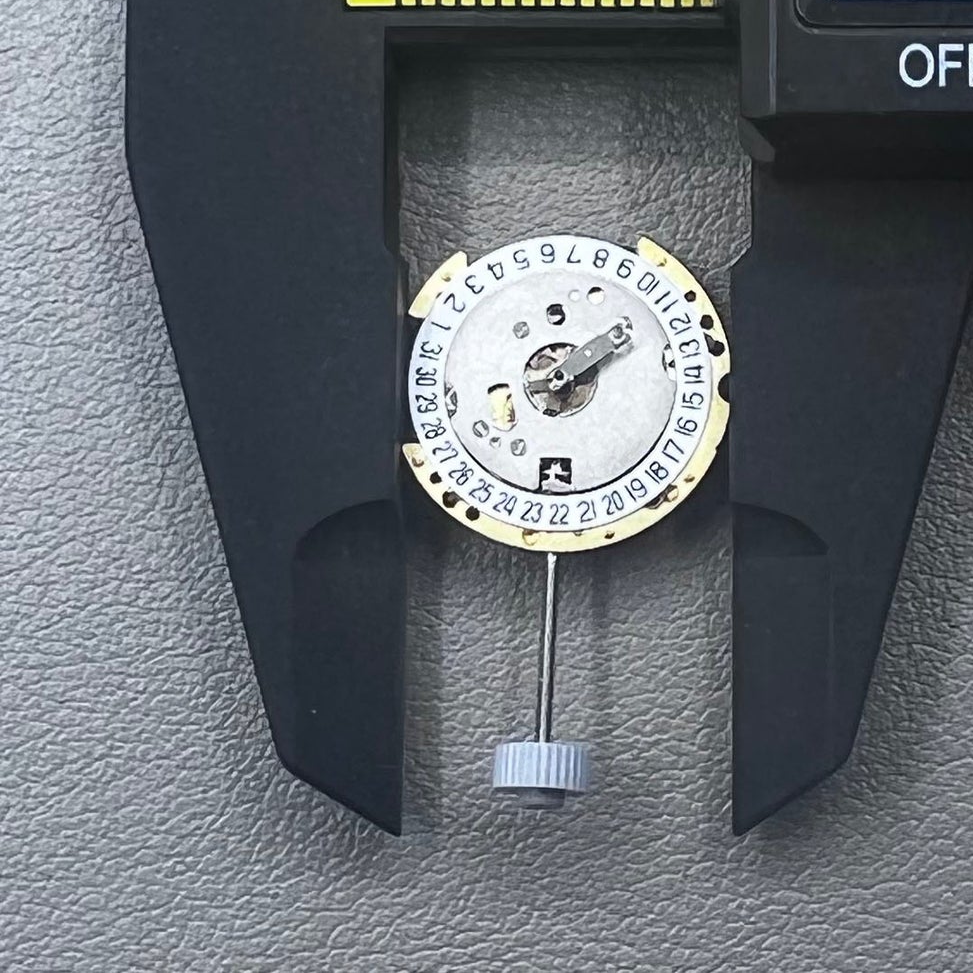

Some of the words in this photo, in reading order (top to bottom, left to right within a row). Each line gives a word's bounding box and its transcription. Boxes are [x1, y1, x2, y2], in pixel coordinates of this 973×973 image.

[513, 249, 530, 270] 5
[541, 243, 555, 263] 6
[567, 244, 581, 263] 7
[593, 248, 609, 268] 8
[487, 262, 504, 280] 4
[617, 259, 635, 278] 9
[465, 275, 485, 294] 3
[637, 271, 660, 296] 10
[443, 293, 466, 313] 2
[654, 290, 679, 312] 11
[431, 321, 451, 331] 1
[669, 312, 692, 336] 12
[419, 340, 443, 361] 31
[679, 339, 701, 359] 13
[415, 366, 437, 386] 30
[684, 365, 705, 384] 14
[415, 393, 438, 413] 29
[681, 392, 704, 410] 15
[421, 418, 446, 439] 28
[674, 416, 698, 438] 16
[432, 441, 459, 463] 27
[662, 438, 684, 463] 17
[448, 461, 474, 486] 26
[644, 461, 669, 484] 18
[468, 478, 495, 503] 25
[624, 478, 647, 502] 19
[492, 492, 518, 516] 24
[520, 501, 543, 524] 23
[577, 500, 597, 523] 21
[602, 490, 624, 516] 20
[549, 504, 569, 525] 22
